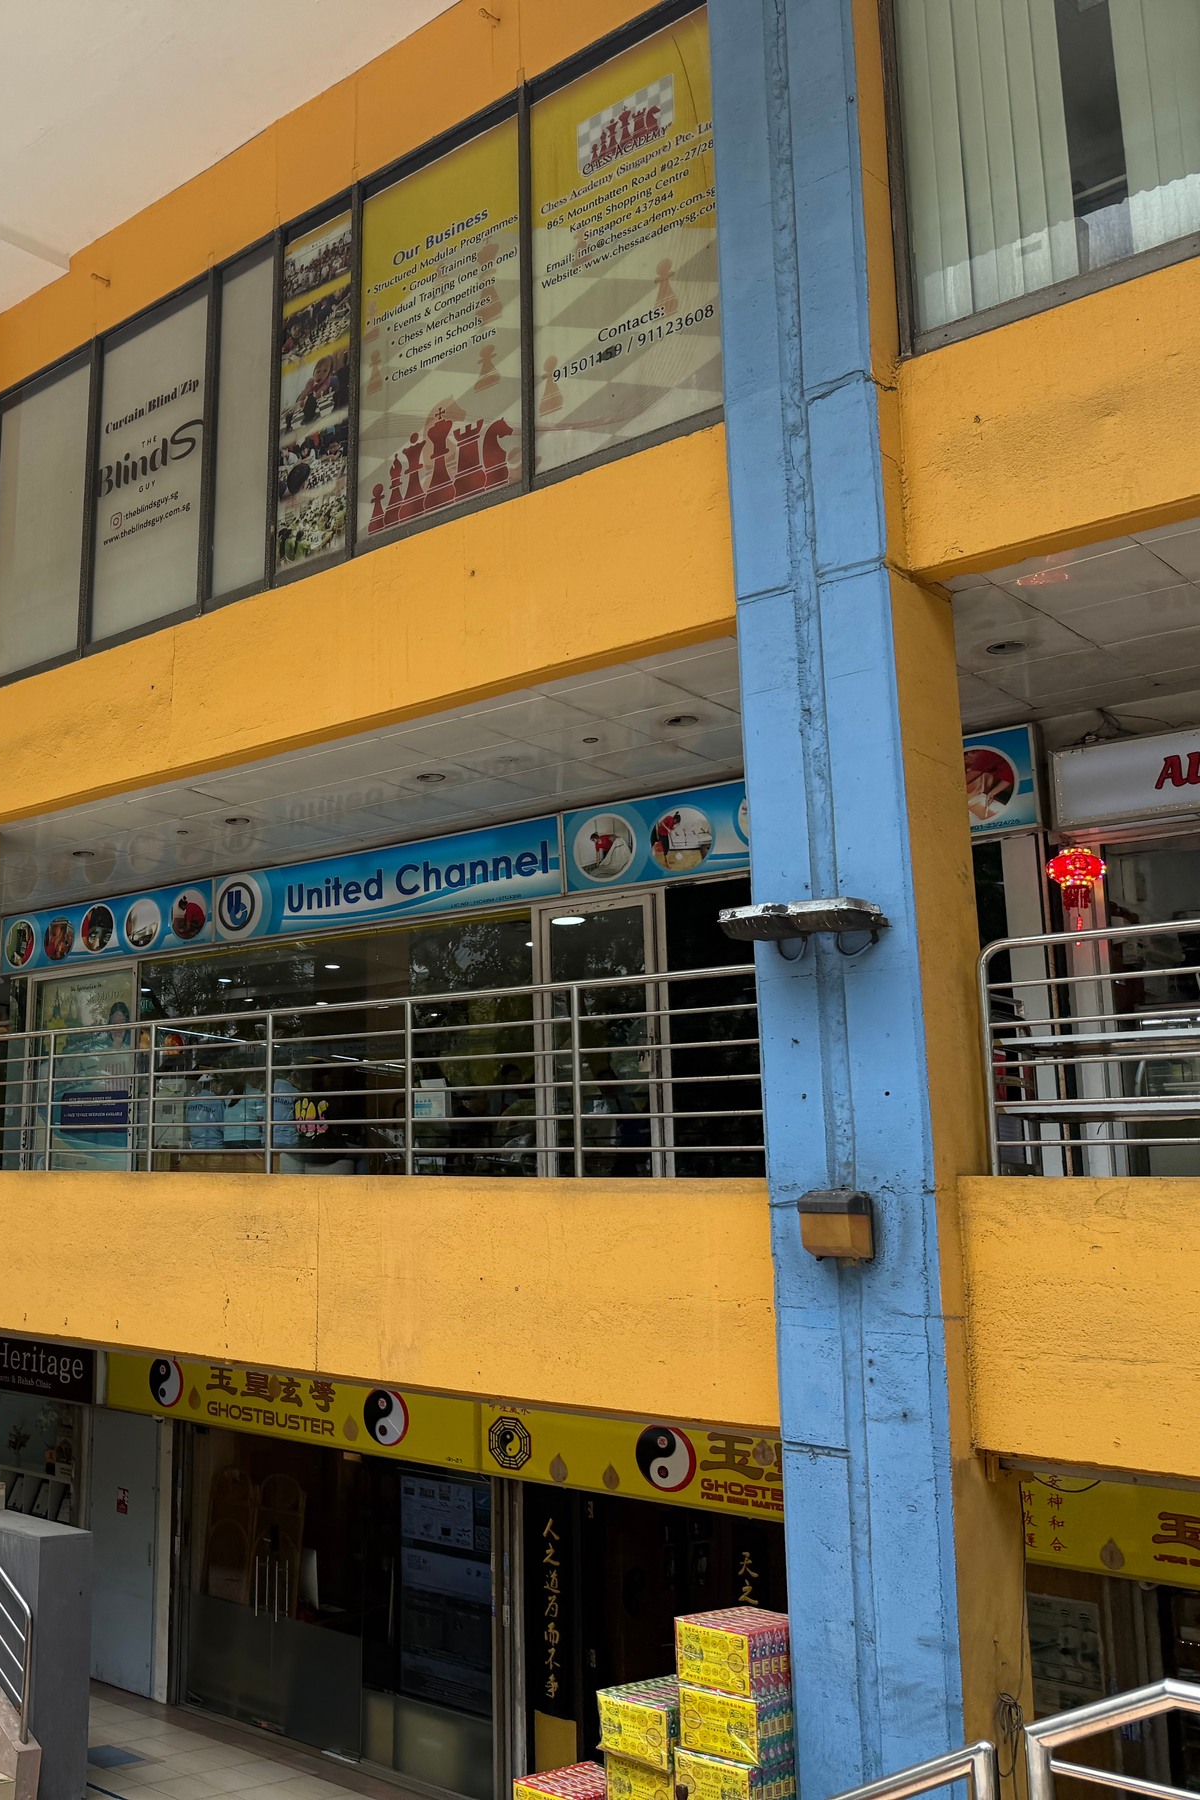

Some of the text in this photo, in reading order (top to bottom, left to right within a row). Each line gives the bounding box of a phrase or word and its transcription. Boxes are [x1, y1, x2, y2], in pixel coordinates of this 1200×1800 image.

[582, 124, 669, 177] CHESS ACADEMY
[541, 197, 568, 214] Chess
[570, 172, 614, 200] Academy
[616, 140, 672, 178] (Singapore)
[546, 215, 564, 231] 865
[567, 183, 628, 221] Mountbatten
[631, 167, 657, 188] Road
[569, 168, 690, 233] Katong Shopping Centre
[393, 208, 489, 267] Our Business
[583, 189, 674, 241] Singapore 437844
[373, 213, 519, 294] Structured Modular Programmes
[409, 252, 478, 292] Group Training
[542, 263, 582, 289] Website:
[546, 254, 575, 274] Email:
[373, 246, 518, 326] Individual Training (one on one)
[393, 276, 496, 332] Events & Competitions
[397, 296, 491, 346] Chess Merchandizes
[405, 316, 483, 359] Chess in Schools
[597, 306, 665, 343] Contacts:
[627, 336, 634, 354] /
[638, 304, 714, 347] 91123608
[392, 328, 497, 382] Chess Immersion Tours
[141, 434, 158, 448] THE
[138, 480, 156, 493] GUY
[103, 502, 191, 546] www.theblindsguy.com.sg
[287, 840, 551, 915] United Channel
[11, 1375, 16, 1384] &
[17, 1375, 34, 1386] Rehab
[35, 1378, 52, 1390] Clinic
[205, 1365, 336, 1413] 玉皇玄學
[206, 1400, 336, 1438] GHOSTBUSTER
[700, 1431, 783, 1482] 玉
[751, 1498, 785, 1513] MASTE
[1020, 1480, 1038, 1549] 財改運
